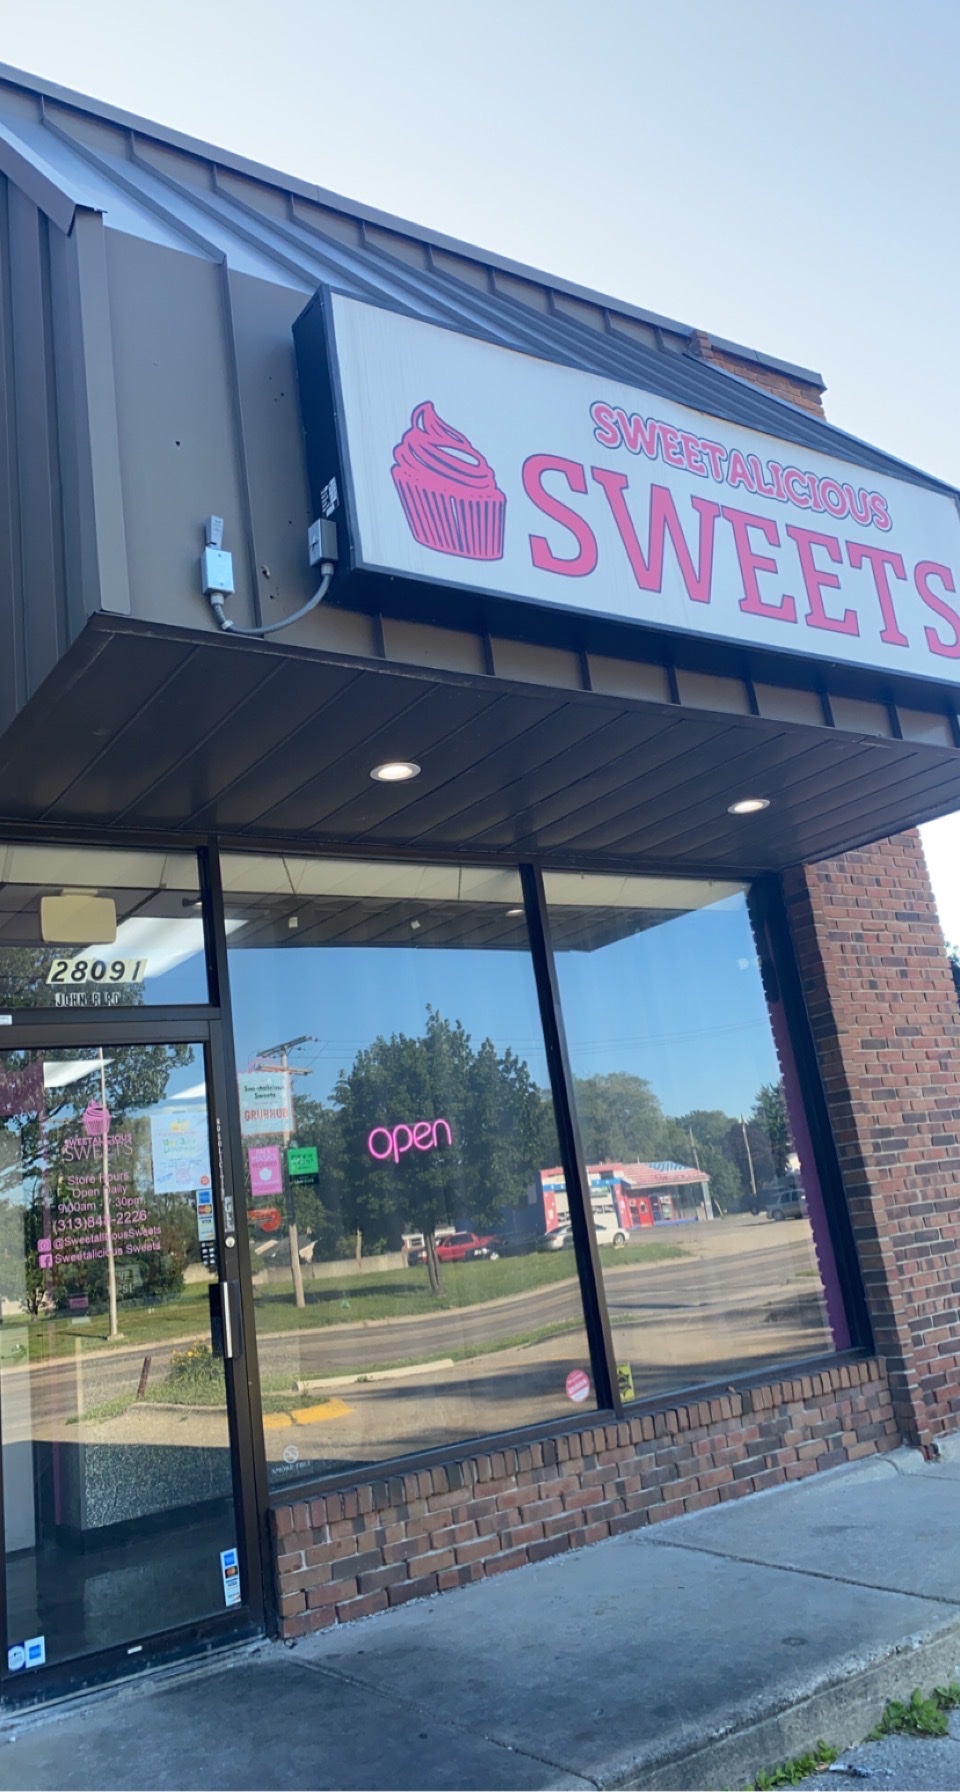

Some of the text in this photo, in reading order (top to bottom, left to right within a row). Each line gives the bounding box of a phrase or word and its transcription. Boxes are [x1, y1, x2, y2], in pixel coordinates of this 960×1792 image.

[590, 400, 893, 532] SWEETALICIOUS
[521, 453, 960, 660] SWEETS
[51, 960, 141, 982] 28091
[55, 993, 87, 1007] JOHN
[244, 1108, 288, 1121] GRUBHUB
[64, 1133, 133, 1148] SWEETALCIOUS
[367, 1118, 452, 1164] open
[64, 1141, 133, 1162] SWEETS
[67, 1172, 130, 1185] Store Hours
[72, 1184, 128, 1199] Open Daily
[53, 1226, 161, 1250] @SweetaliousSweets
[125, 1242, 161, 1254] Sweets
